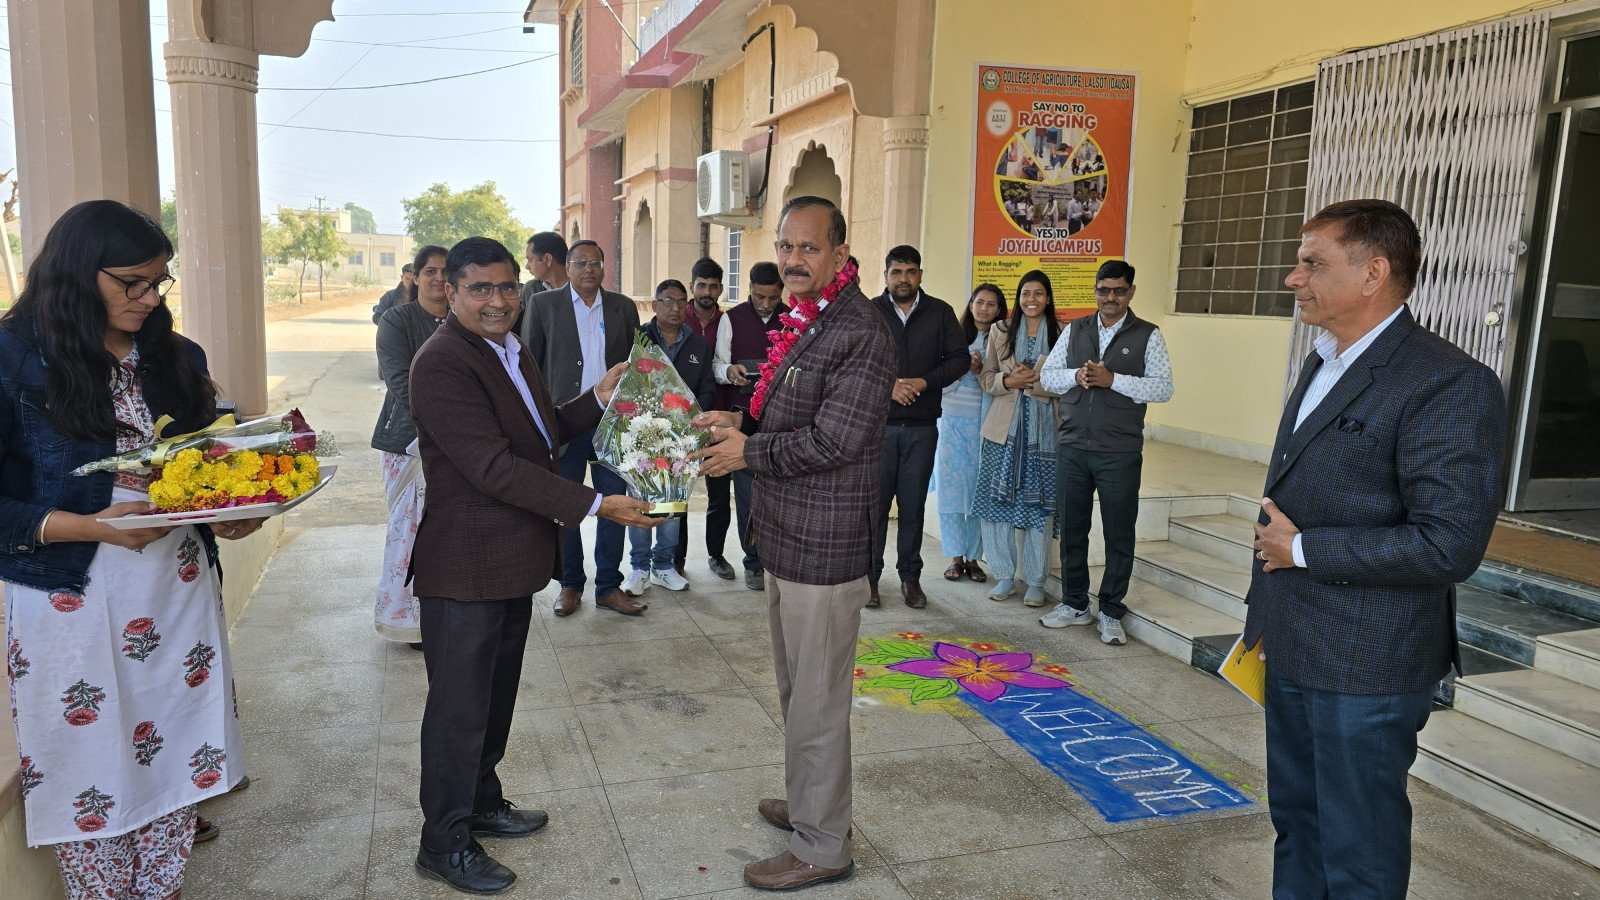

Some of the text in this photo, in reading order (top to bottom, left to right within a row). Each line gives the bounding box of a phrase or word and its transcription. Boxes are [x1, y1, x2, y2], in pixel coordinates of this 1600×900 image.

[1003, 70, 1030, 84] COLLEGE
[1032, 72, 1040, 84] OF
[1041, 73, 1082, 88] AGRICULTURE,
[1084, 76, 1107, 88] LALSOT
[1033, 102, 1084, 113] SAY NO TO
[1019, 112, 1097, 130] RAGGING
[1036, 228, 1068, 238] YES TO
[1000, 240, 1101, 254] JOYFULCAMPUS
[997, 692, 1240, 815] WELCOME
